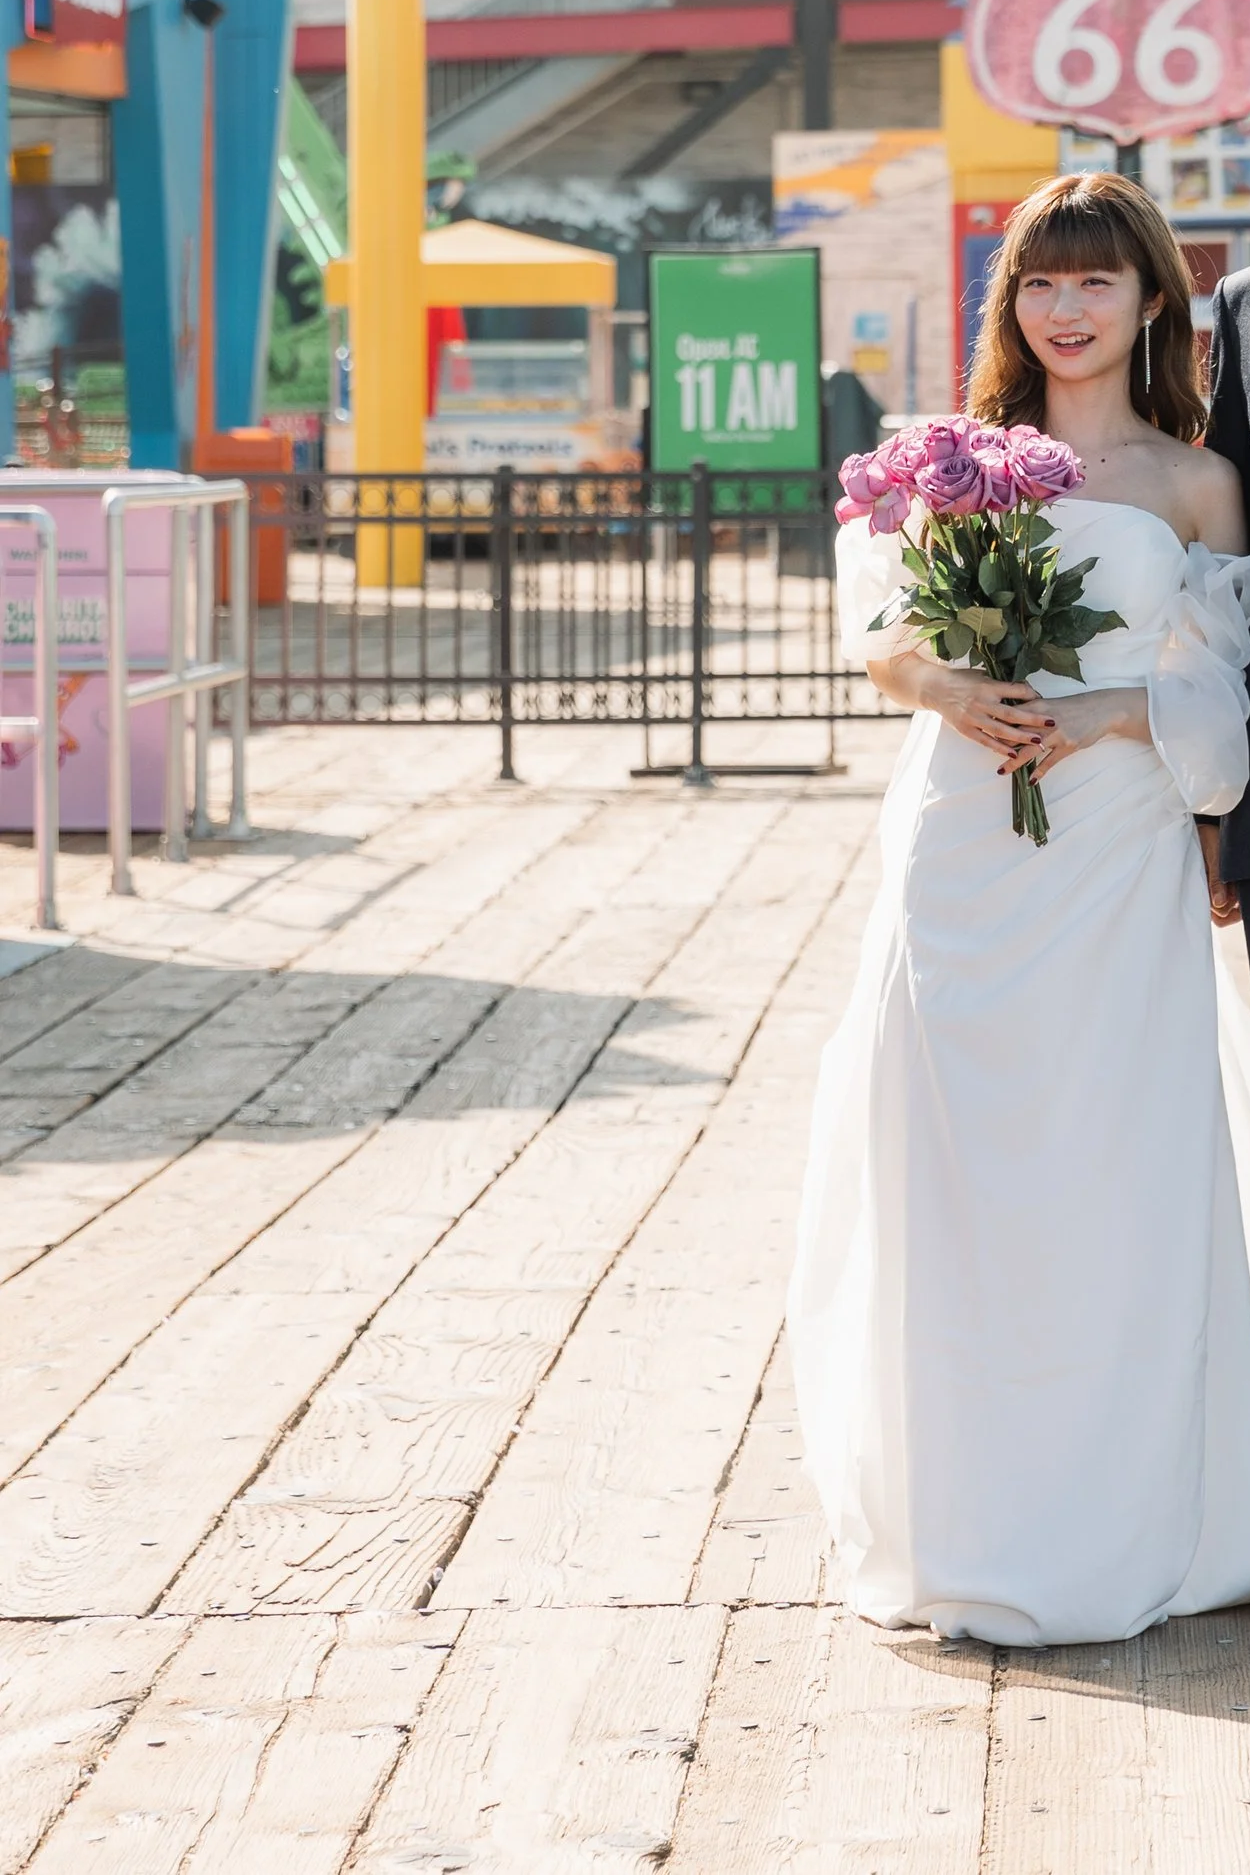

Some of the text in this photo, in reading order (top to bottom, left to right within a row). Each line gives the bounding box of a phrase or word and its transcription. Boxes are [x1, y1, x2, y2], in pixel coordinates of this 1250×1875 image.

[675, 332, 732, 361] Open
[674, 359, 798, 432] 11 AM
